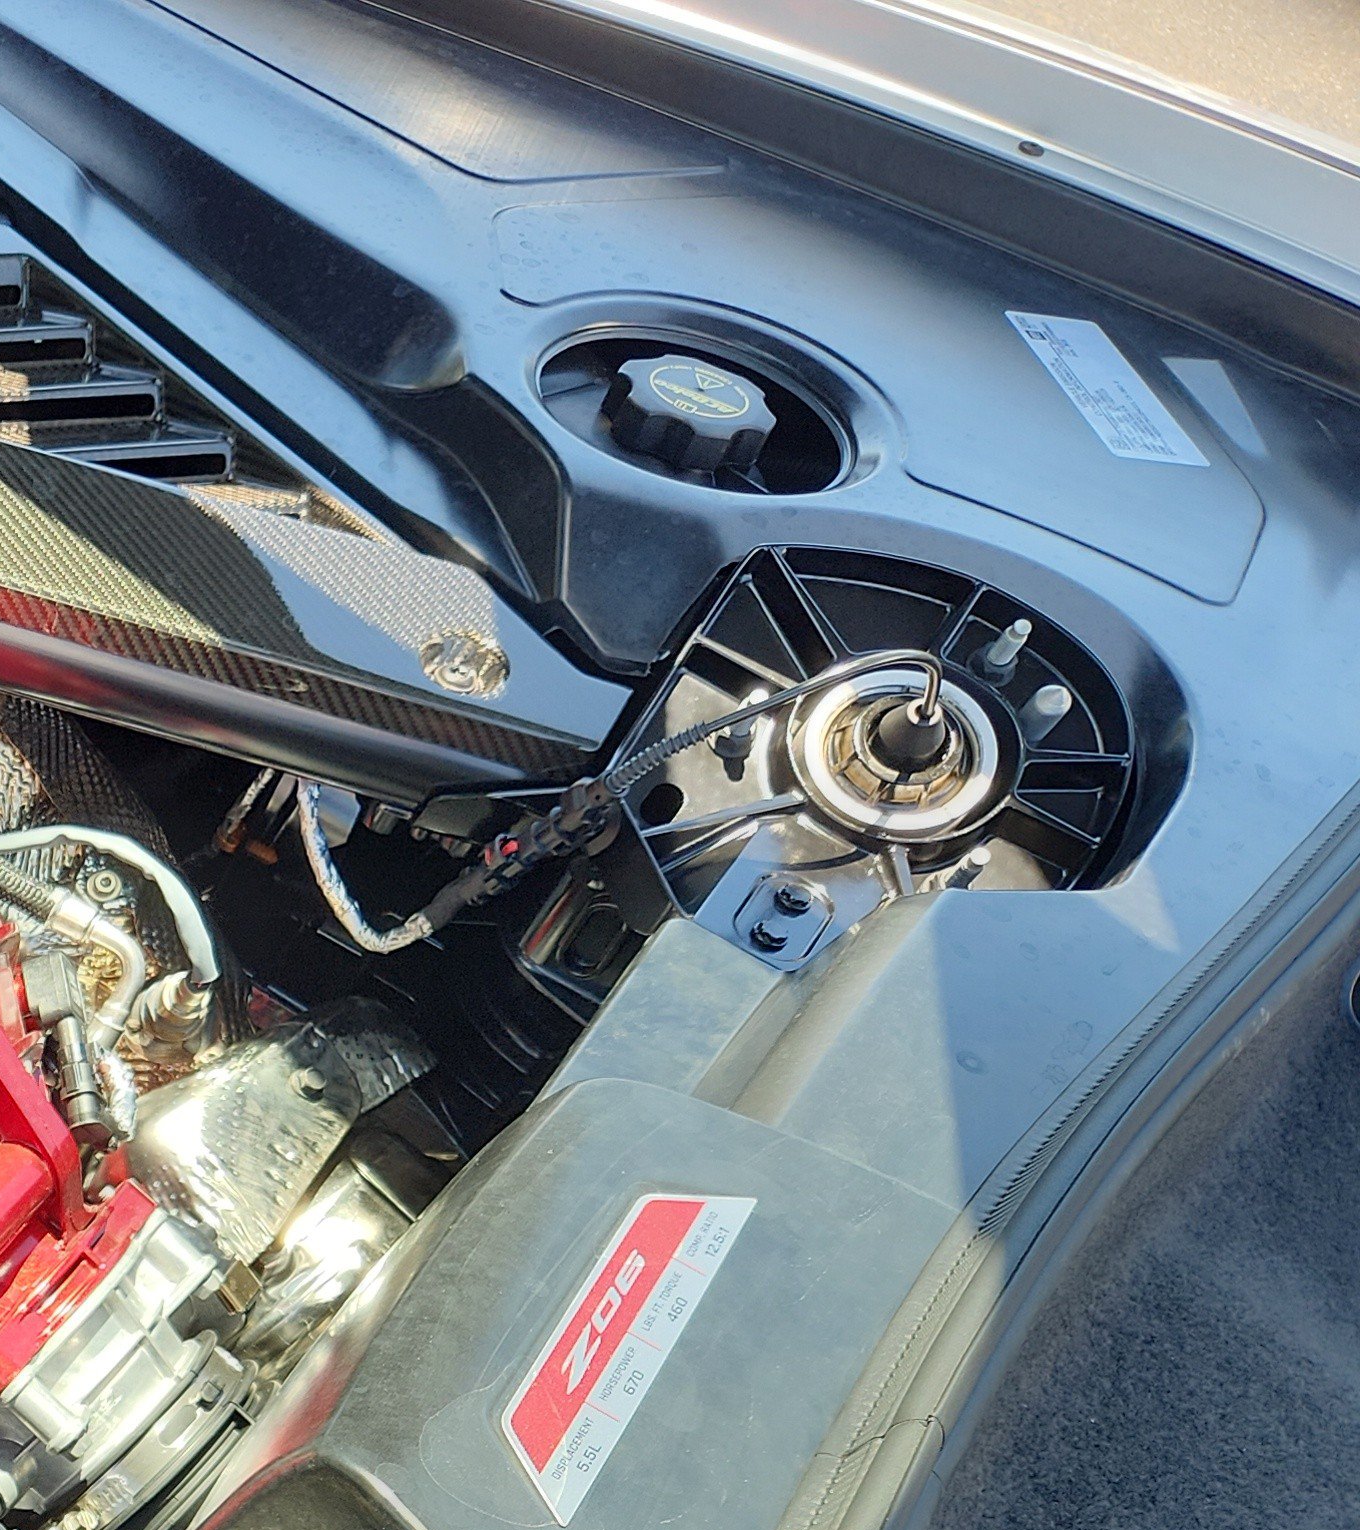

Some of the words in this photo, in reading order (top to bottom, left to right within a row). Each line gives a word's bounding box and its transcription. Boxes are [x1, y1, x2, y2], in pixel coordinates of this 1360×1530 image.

[701, 1211, 719, 1236] RATIO
[705, 1226, 730, 1258] 12.5:1
[641, 1314, 657, 1332] LBS.
[659, 1272, 683, 1301] TORQUE
[668, 1297, 688, 1322] 460
[560, 1248, 646, 1396] Z06
[599, 1346, 635, 1401] HORSEPOWER
[623, 1370, 645, 1396] 670
[551, 1416, 594, 1480] DISPLACEMENT
[576, 1445, 602, 1473] 5.5L
